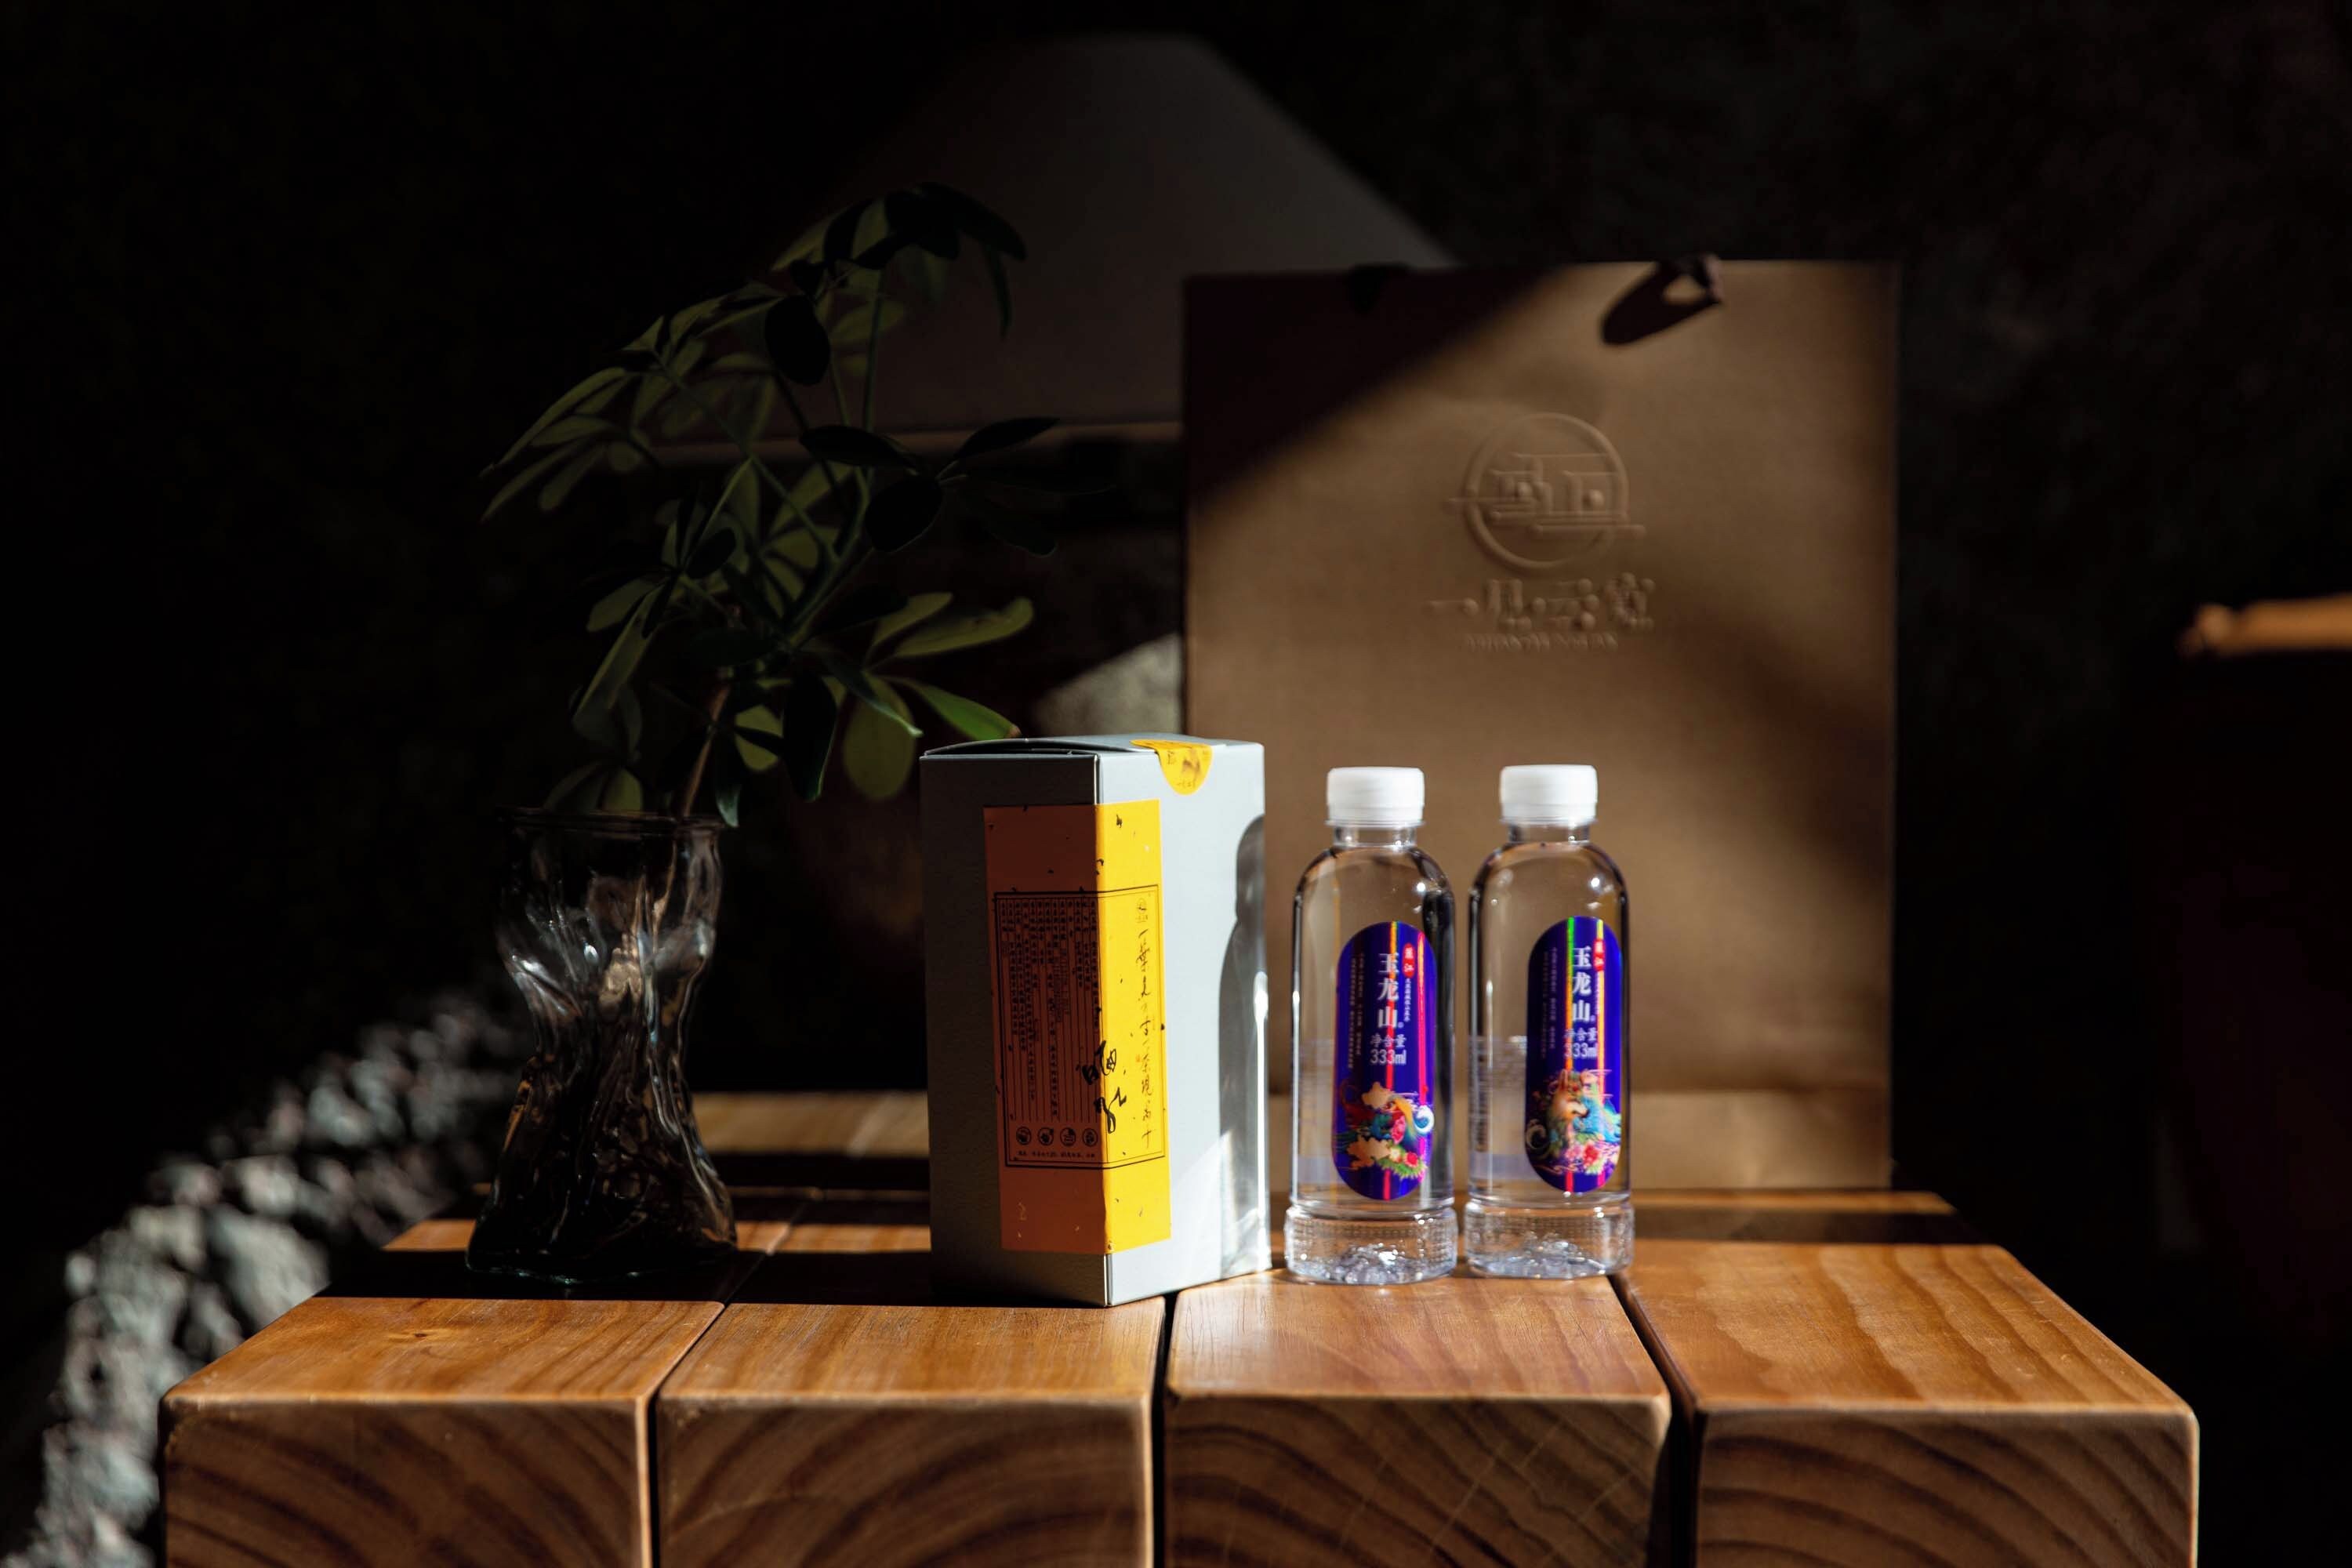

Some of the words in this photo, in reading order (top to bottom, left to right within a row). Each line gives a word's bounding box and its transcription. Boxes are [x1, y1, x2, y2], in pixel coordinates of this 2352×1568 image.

[1377, 953, 1400, 1029] 玉龙山
[1572, 946, 1592, 1022] 玉龙山
[1368, 1032, 1407, 1048] 净含量
[1369, 1048, 1407, 1065] 333ml
